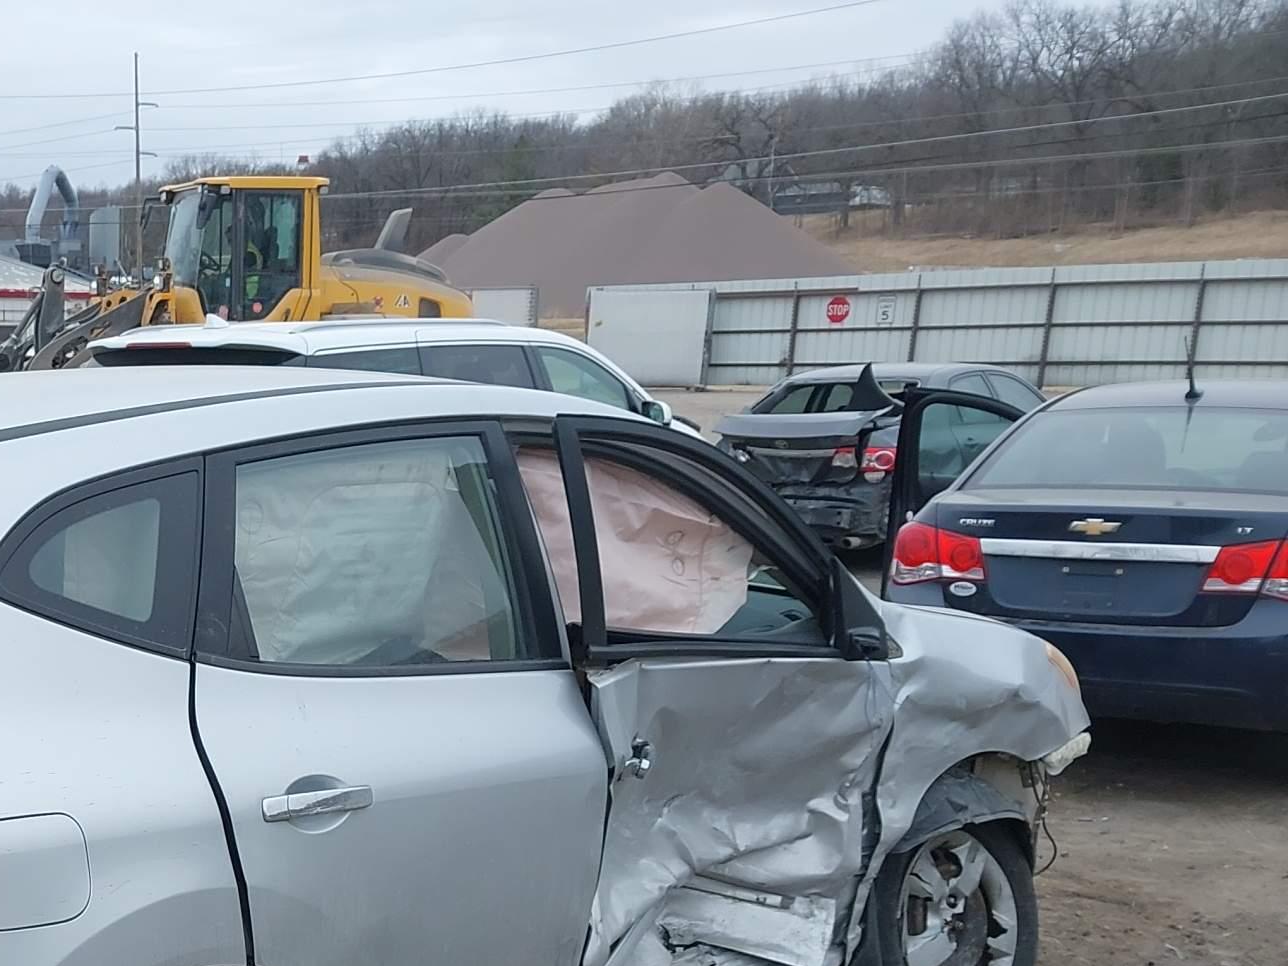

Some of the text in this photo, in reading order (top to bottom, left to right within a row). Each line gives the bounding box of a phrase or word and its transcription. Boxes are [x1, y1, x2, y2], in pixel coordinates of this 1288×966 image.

[828, 304, 849, 316] STOP
[881, 310, 889, 321] 5
[959, 518, 996, 528] CRUZE
[1237, 527, 1254, 535] LT
